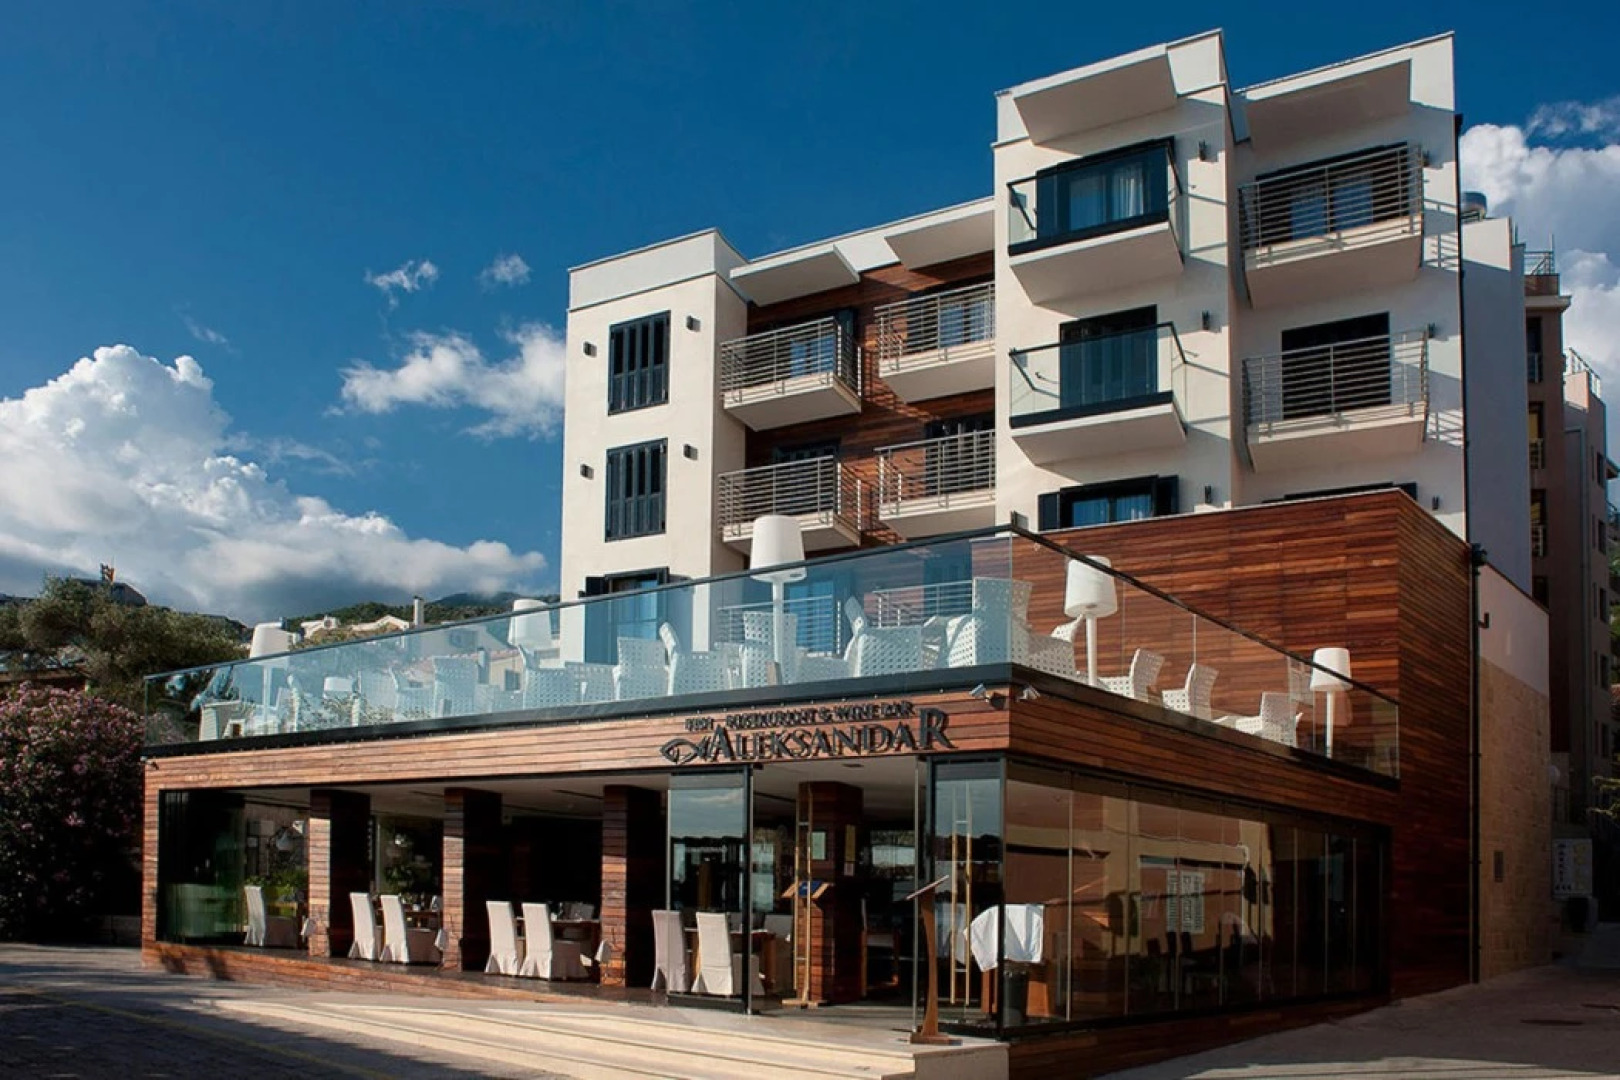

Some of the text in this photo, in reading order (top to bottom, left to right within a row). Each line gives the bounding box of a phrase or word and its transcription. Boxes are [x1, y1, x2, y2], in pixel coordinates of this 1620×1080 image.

[819, 706, 832, 722] &
[834, 703, 879, 721] WINE
[881, 700, 915, 718] BAR
[706, 708, 957, 761] ALEKSANDAR
